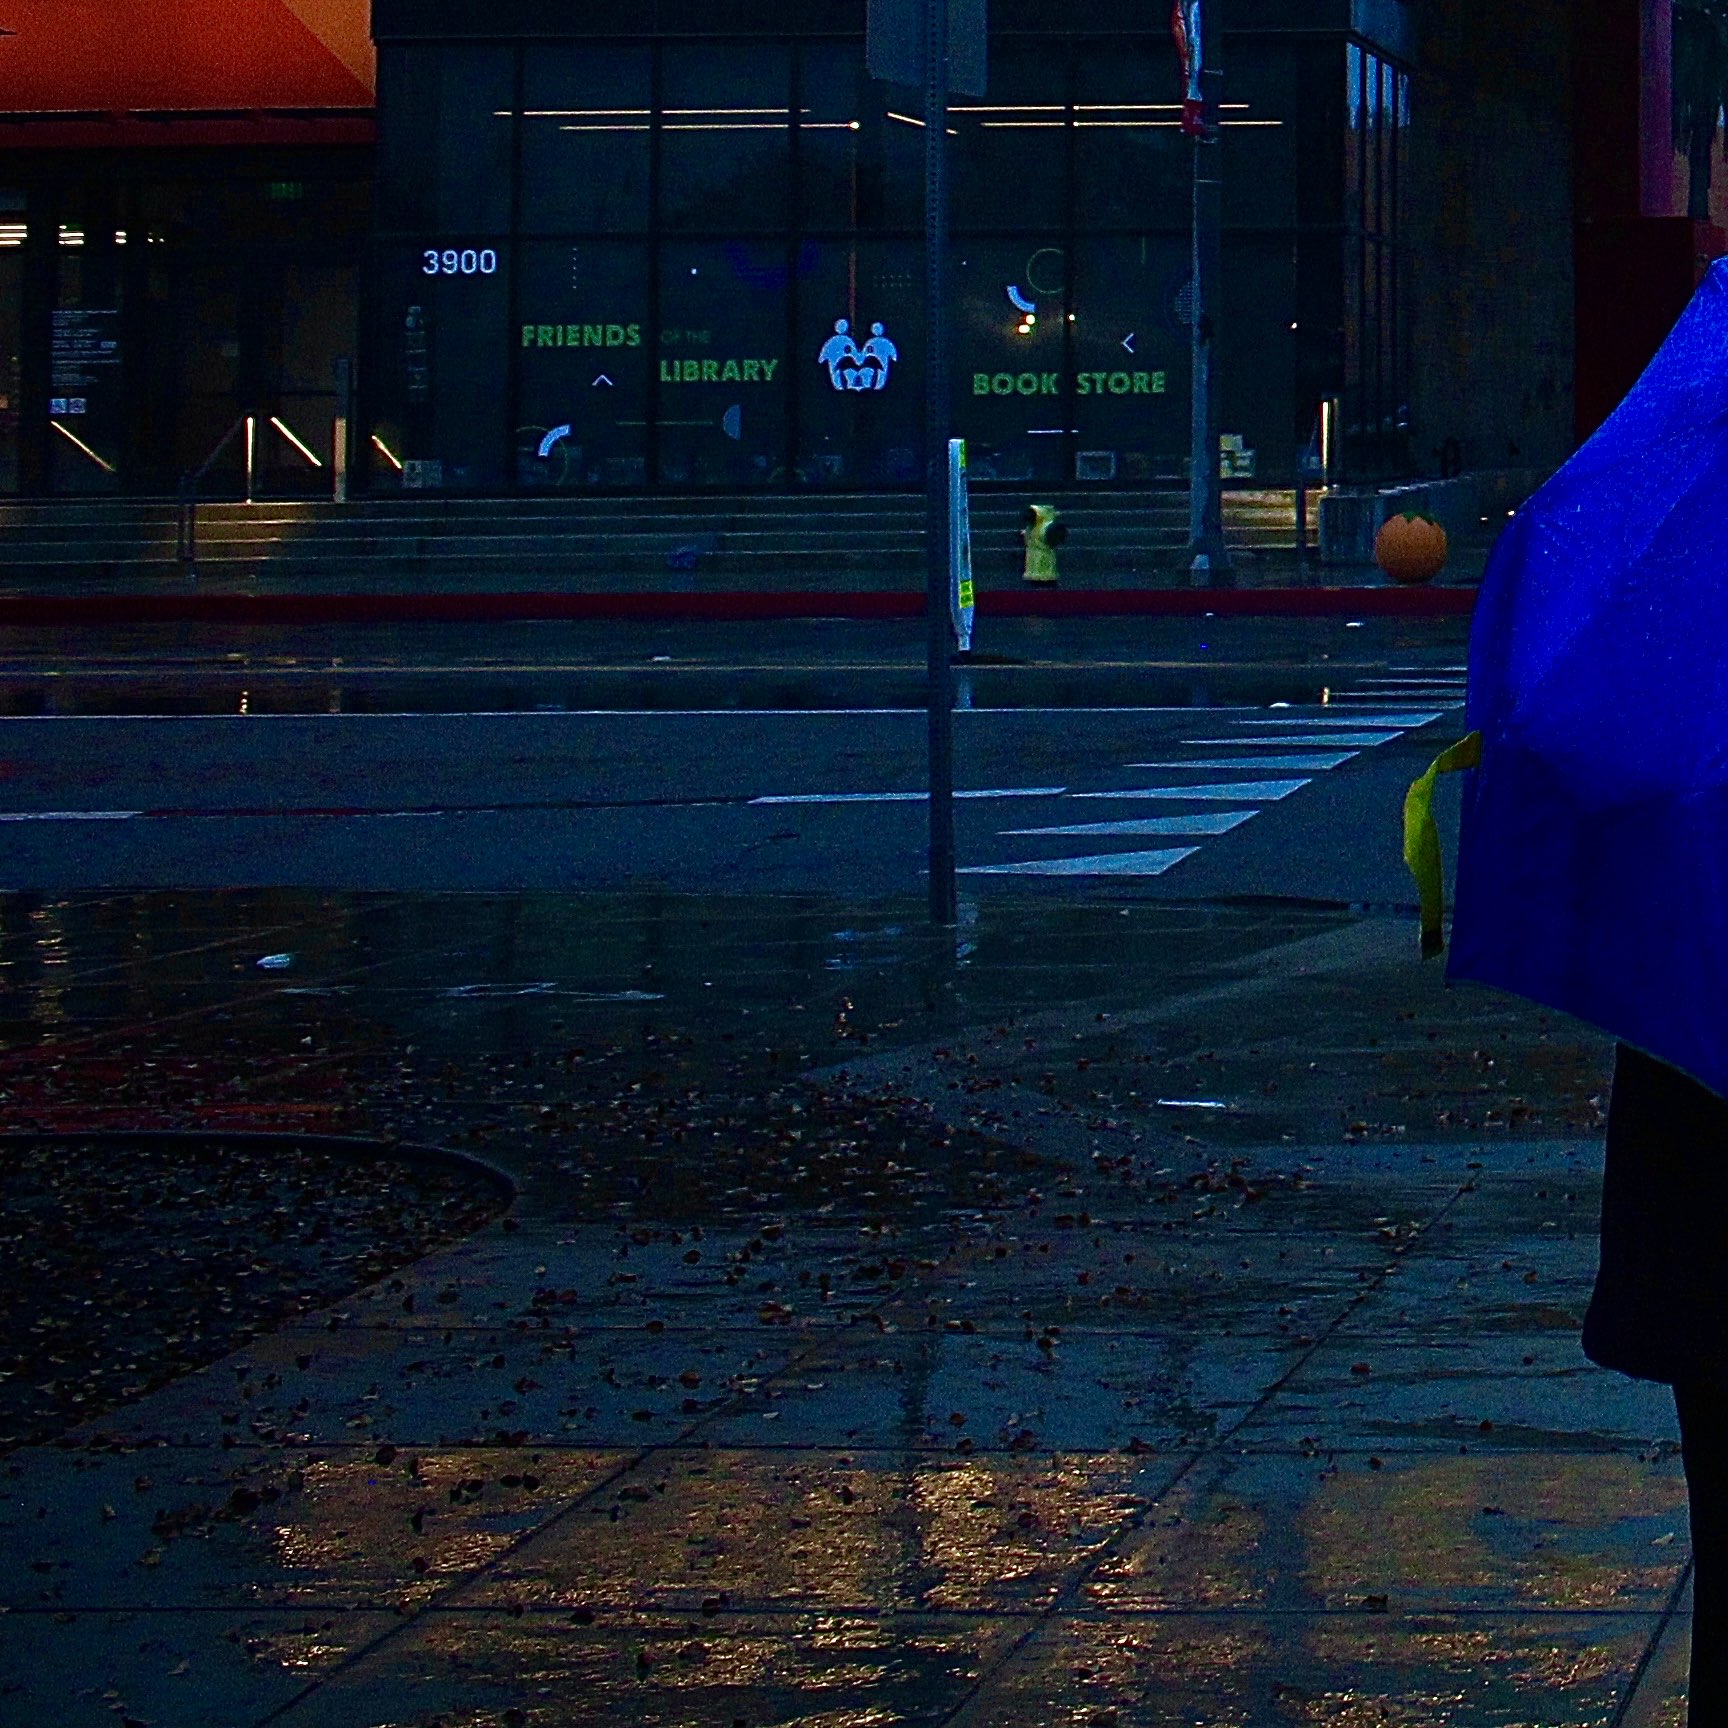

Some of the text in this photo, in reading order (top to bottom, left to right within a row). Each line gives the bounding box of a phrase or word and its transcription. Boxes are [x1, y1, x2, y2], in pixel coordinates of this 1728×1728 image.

[422, 250, 497, 274] 3900
[520, 324, 641, 348] FRIENDS
[659, 358, 779, 382] LIBRARY
[972, 372, 1166, 395] BOOK STORE
